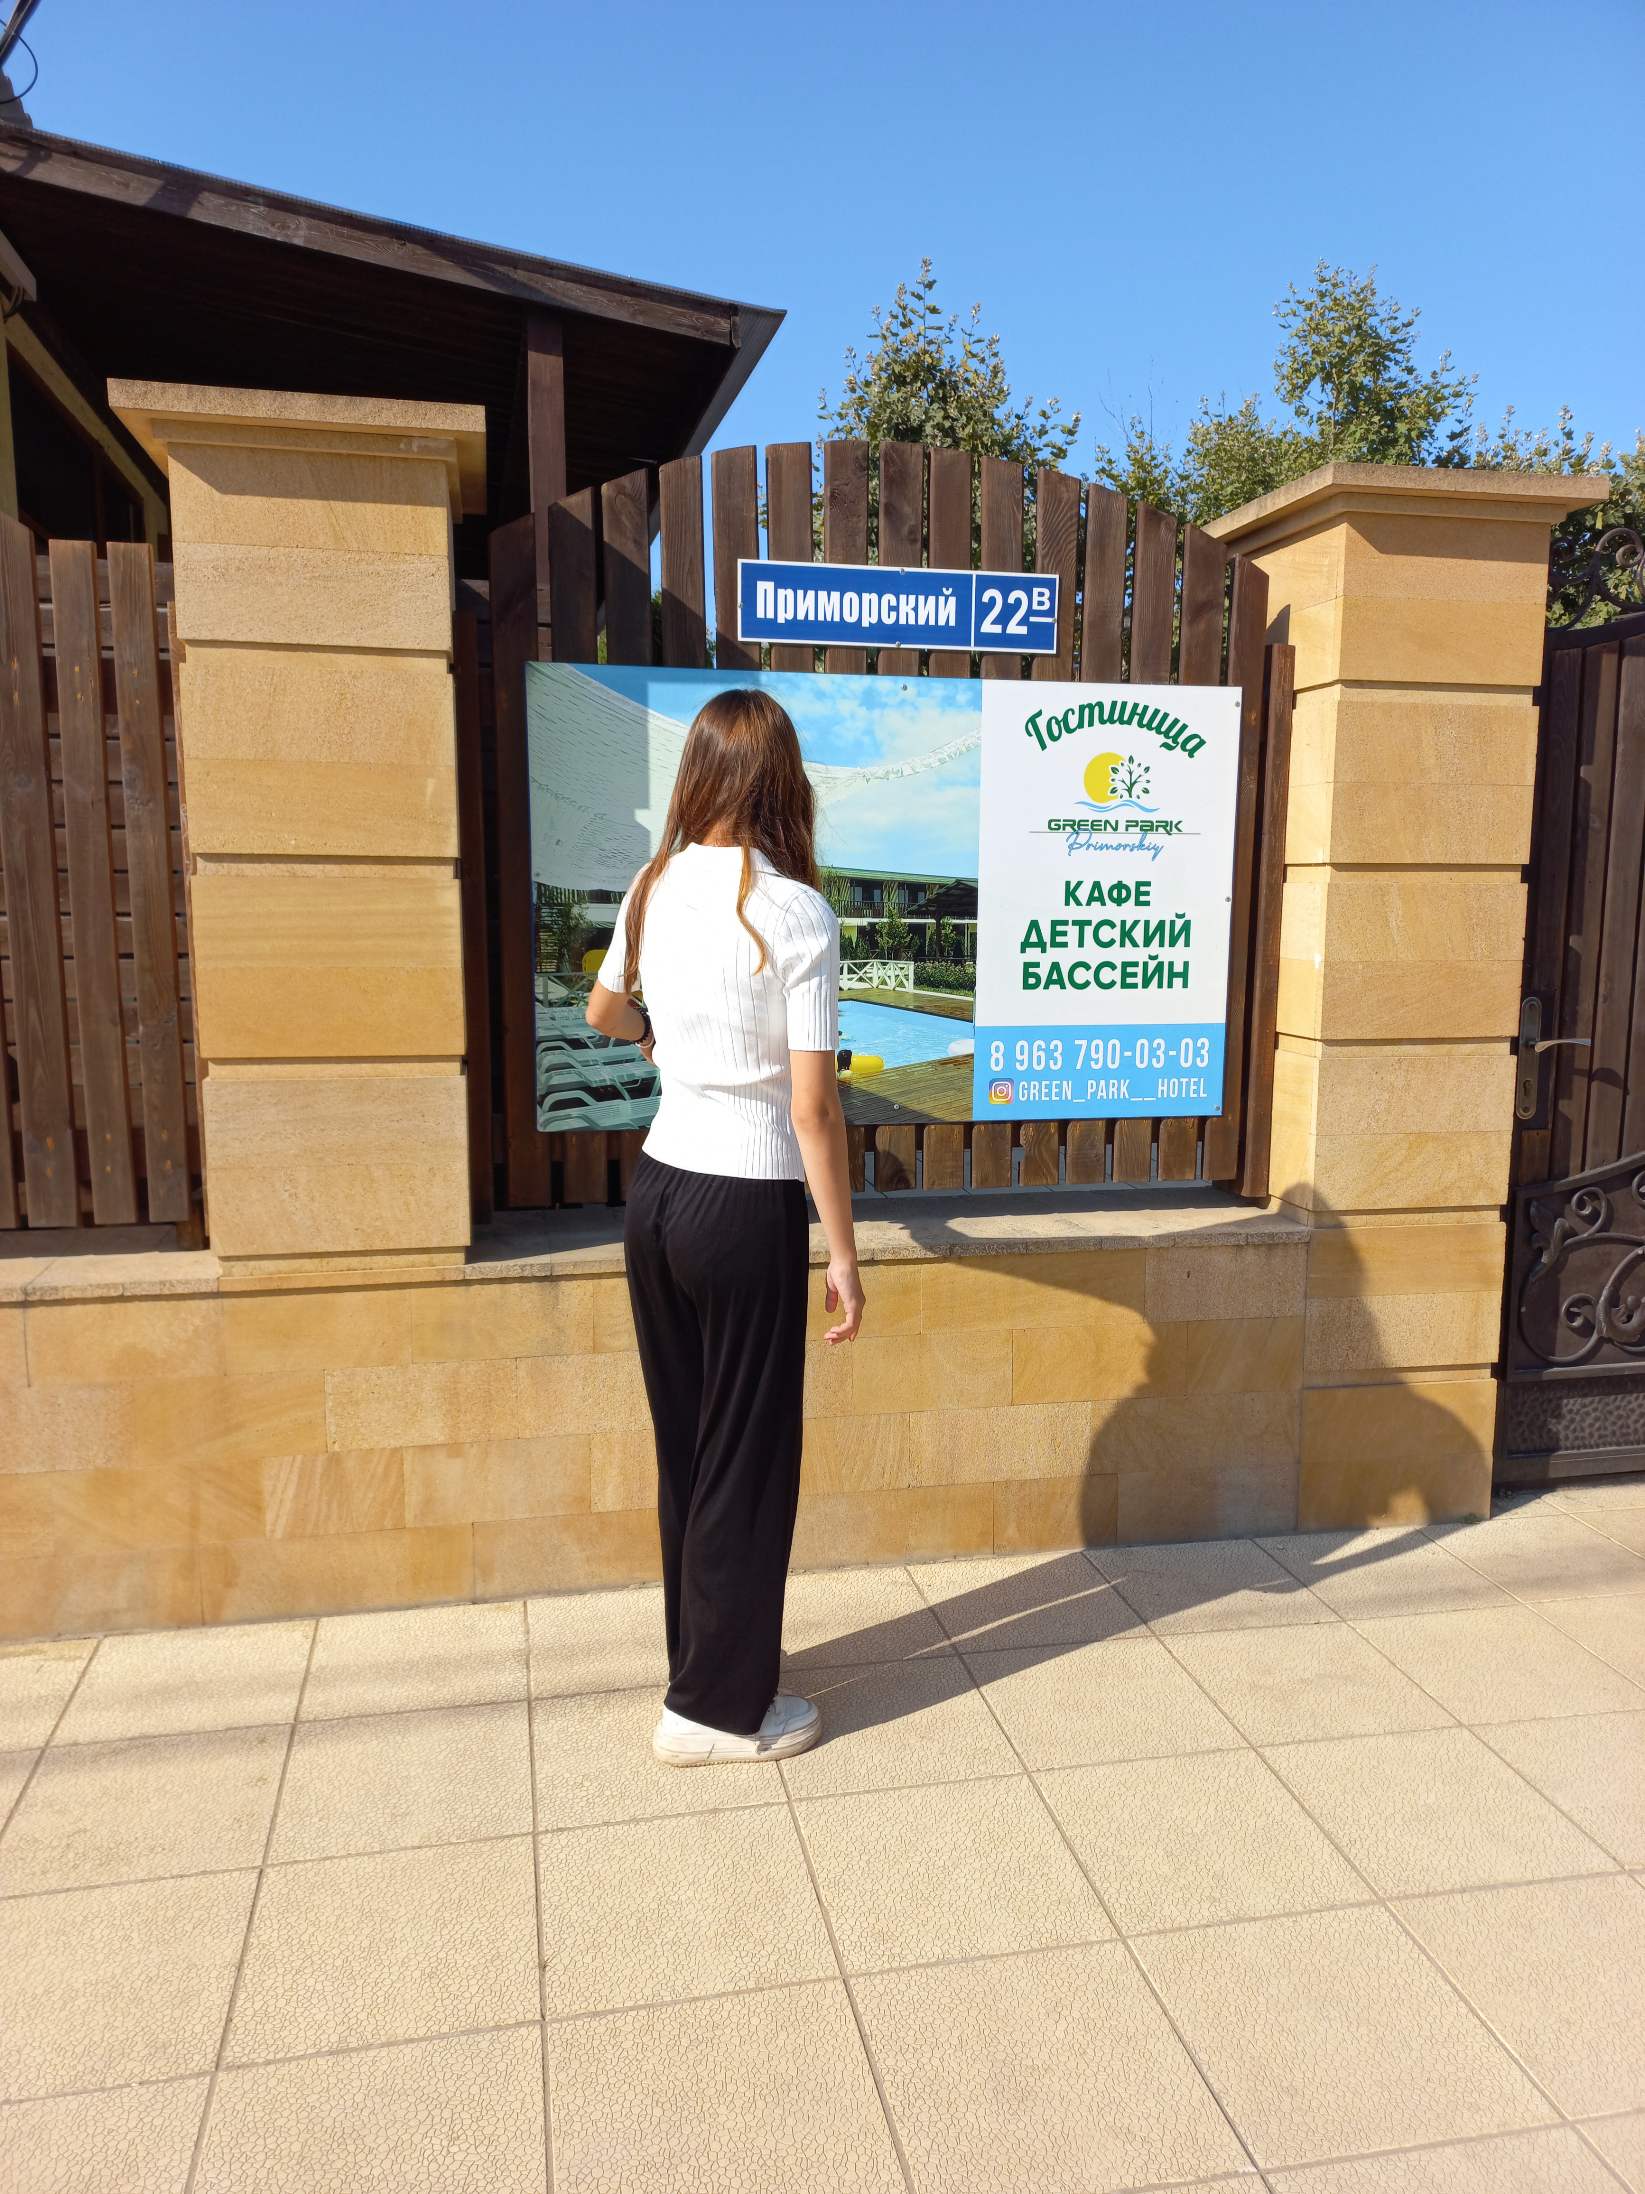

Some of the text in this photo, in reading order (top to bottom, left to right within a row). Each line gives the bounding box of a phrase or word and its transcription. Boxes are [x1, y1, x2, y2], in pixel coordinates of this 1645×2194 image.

[756, 580, 957, 627] Приморский
[1024, 700, 1207, 759] Гостиница
[1047, 818, 1119, 833] GREEN
[1065, 828, 1165, 862] Primorskiy
[1064, 880, 1152, 907] КАФЕ
[1020, 912, 1192, 954] ДЕТСКИЙ
[1022, 954, 1190, 990] БАССЕЙН
[990, 1037, 1210, 1071] 8 963 790-03-03
